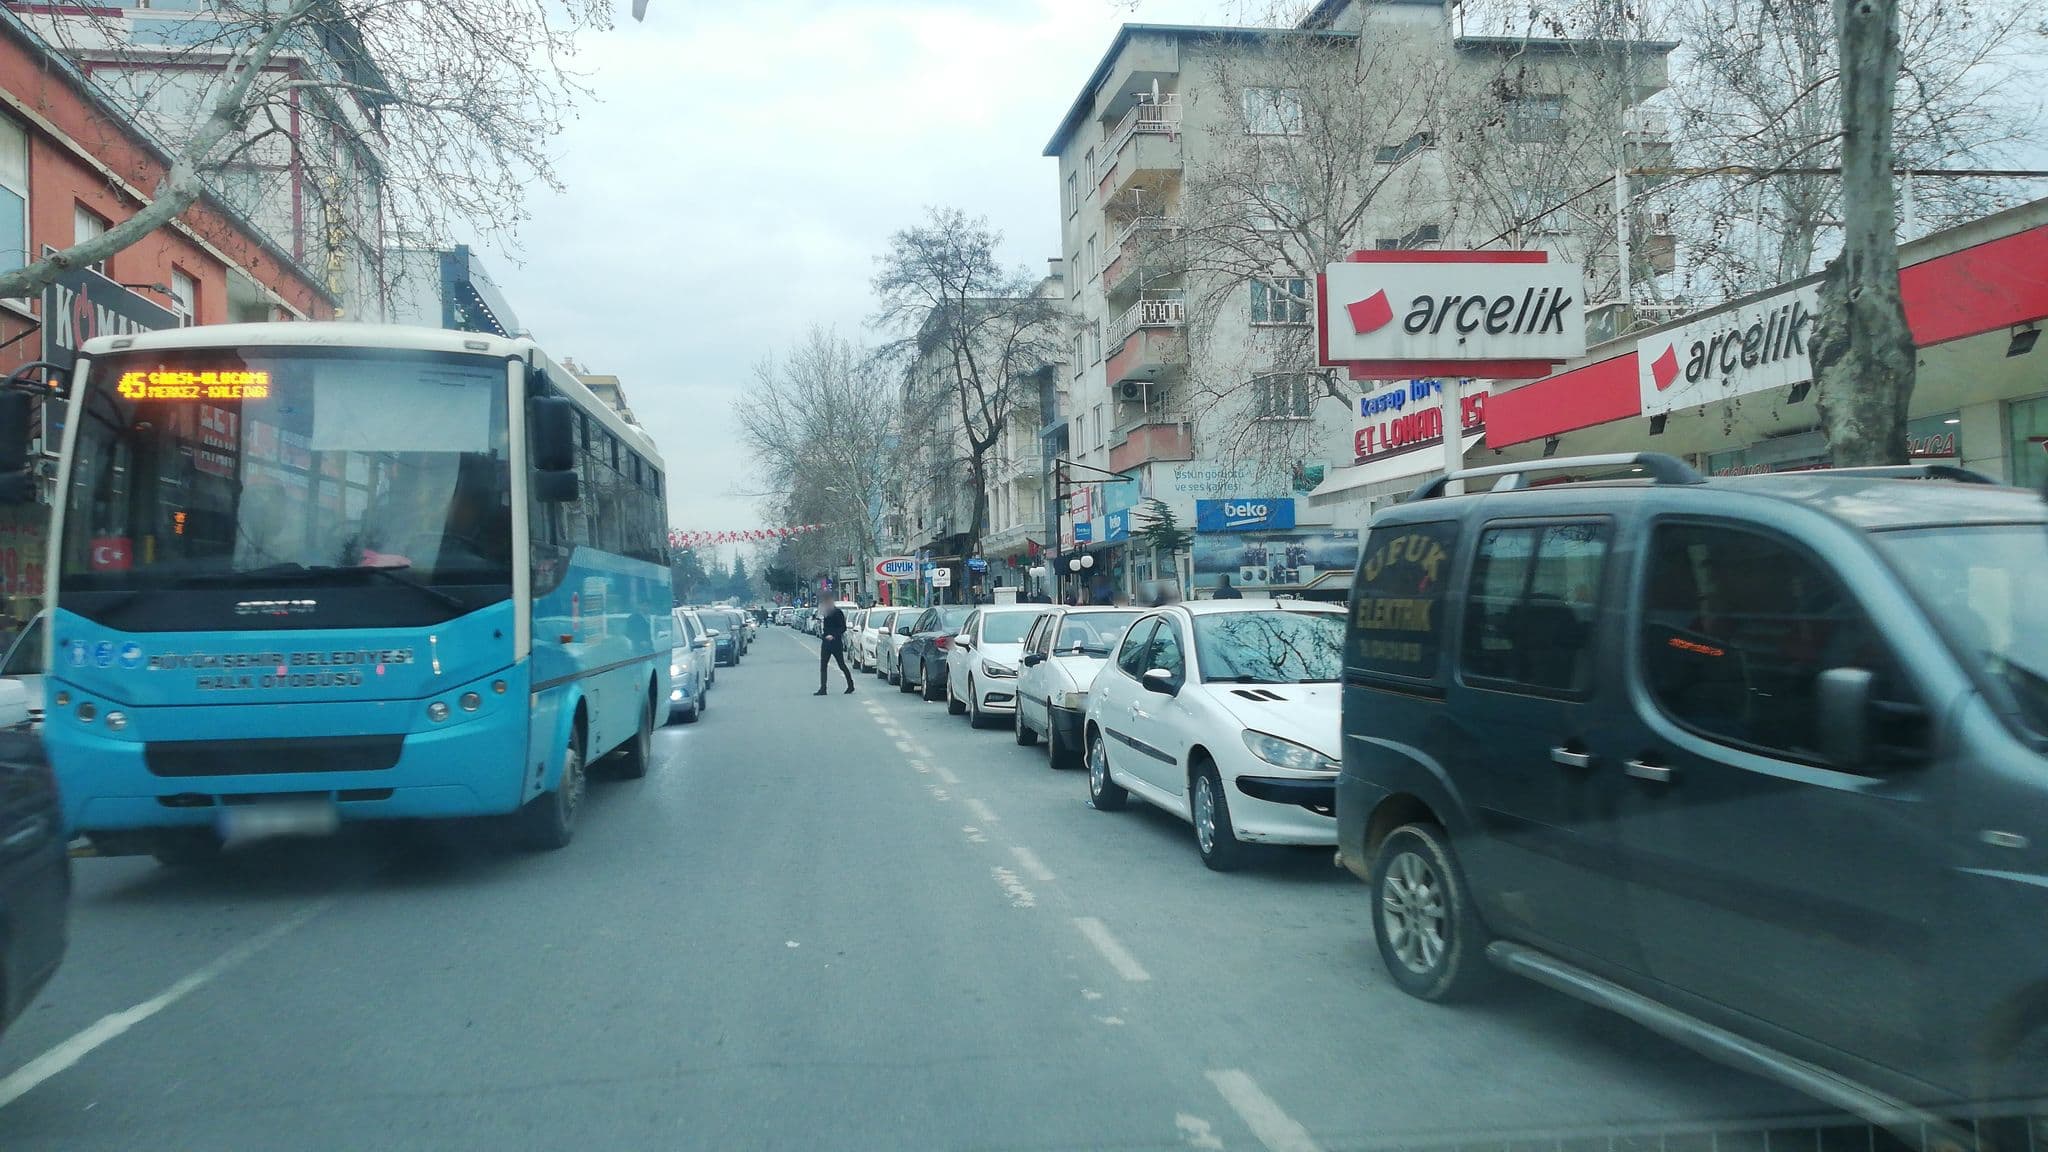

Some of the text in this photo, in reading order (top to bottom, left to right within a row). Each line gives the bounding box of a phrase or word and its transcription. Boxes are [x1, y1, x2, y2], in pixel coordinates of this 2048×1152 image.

[1403, 287, 1573, 344] arçelik
[1685, 300, 1809, 386] arçelik
[117, 372, 146, 398] 45
[1355, 426, 1375, 457] ET
[1224, 502, 1268, 517] beko
[1365, 534, 1447, 582] UFUK
